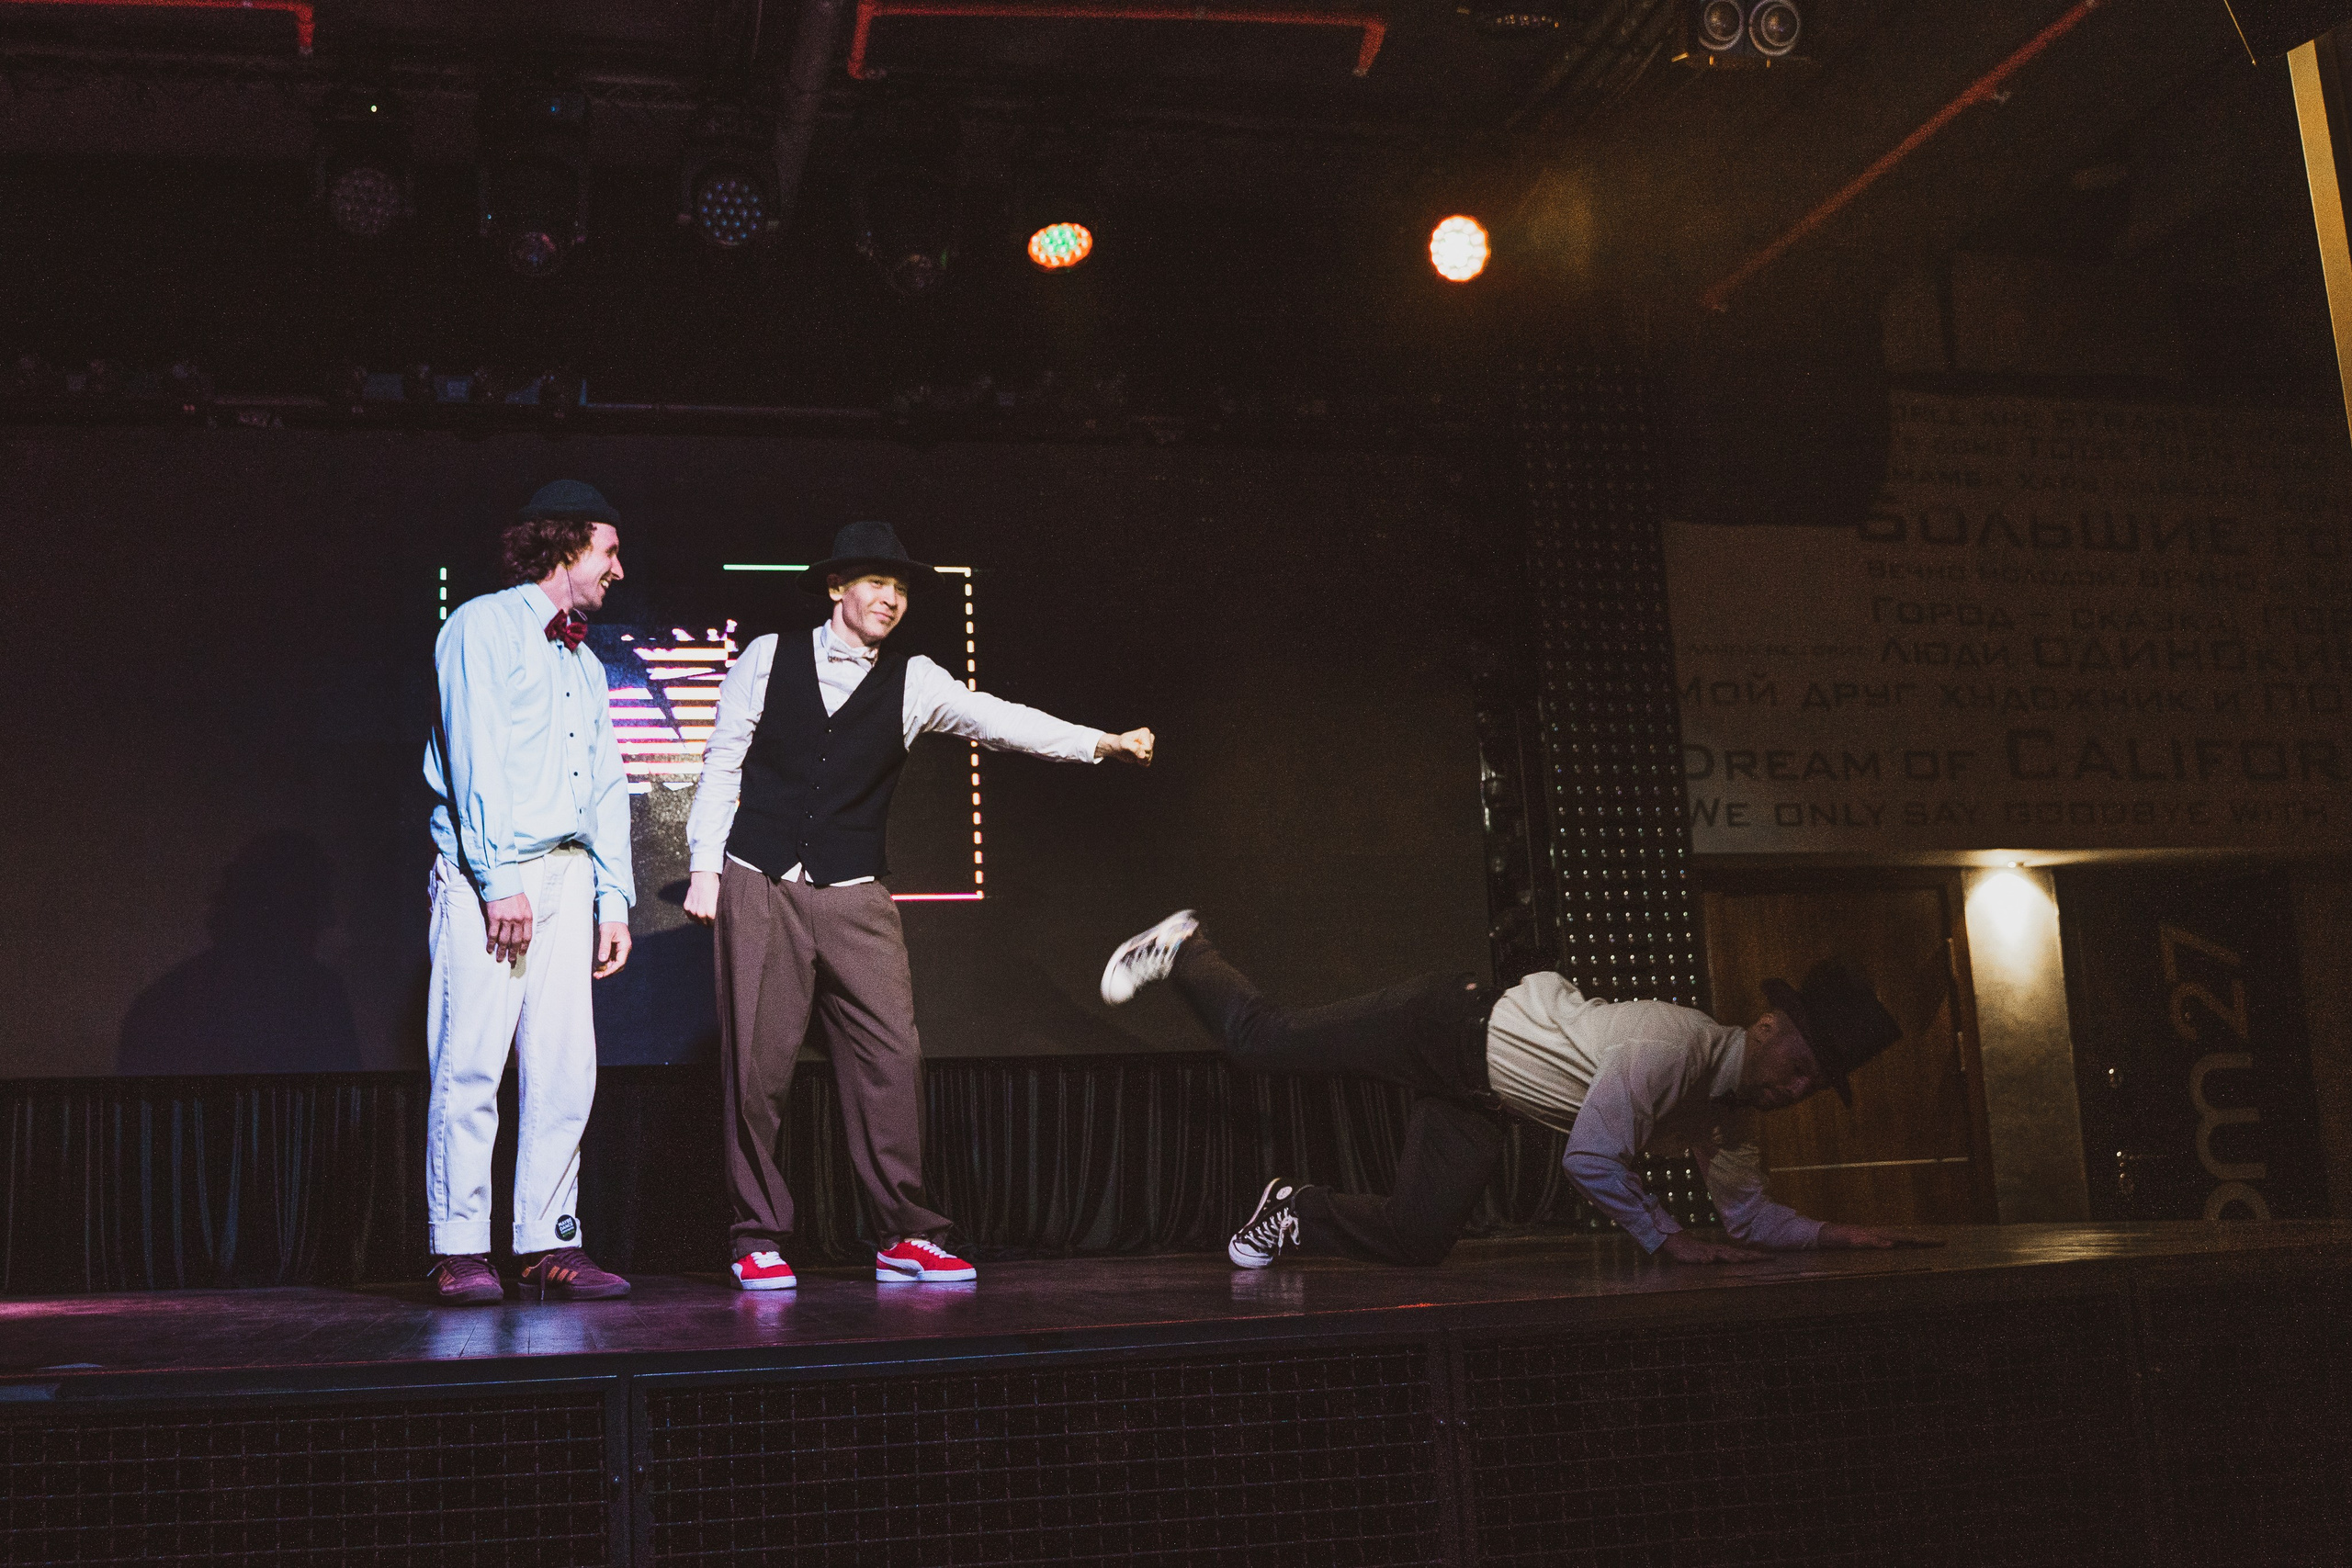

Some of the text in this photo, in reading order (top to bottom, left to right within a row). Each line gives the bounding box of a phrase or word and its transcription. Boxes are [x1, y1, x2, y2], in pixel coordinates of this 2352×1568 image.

[1872, 596, 2016, 631] ГОРОД
[1881, 637, 2010, 671] ЛЮДИ
[1677, 671, 1778, 707] МОЙ
[1802, 682, 1918, 712] ДРУГ
[1939, 683, 2194, 715] ХУДОЖНИК
[1680, 742, 1882, 782] DREAM
[1903, 749, 1975, 781] OF
[1690, 797, 1749, 827] WE
[1773, 801, 1886, 828] ONLY
[1903, 801, 1981, 826] SAY
[2004, 801, 2210, 827] GOODBYE
